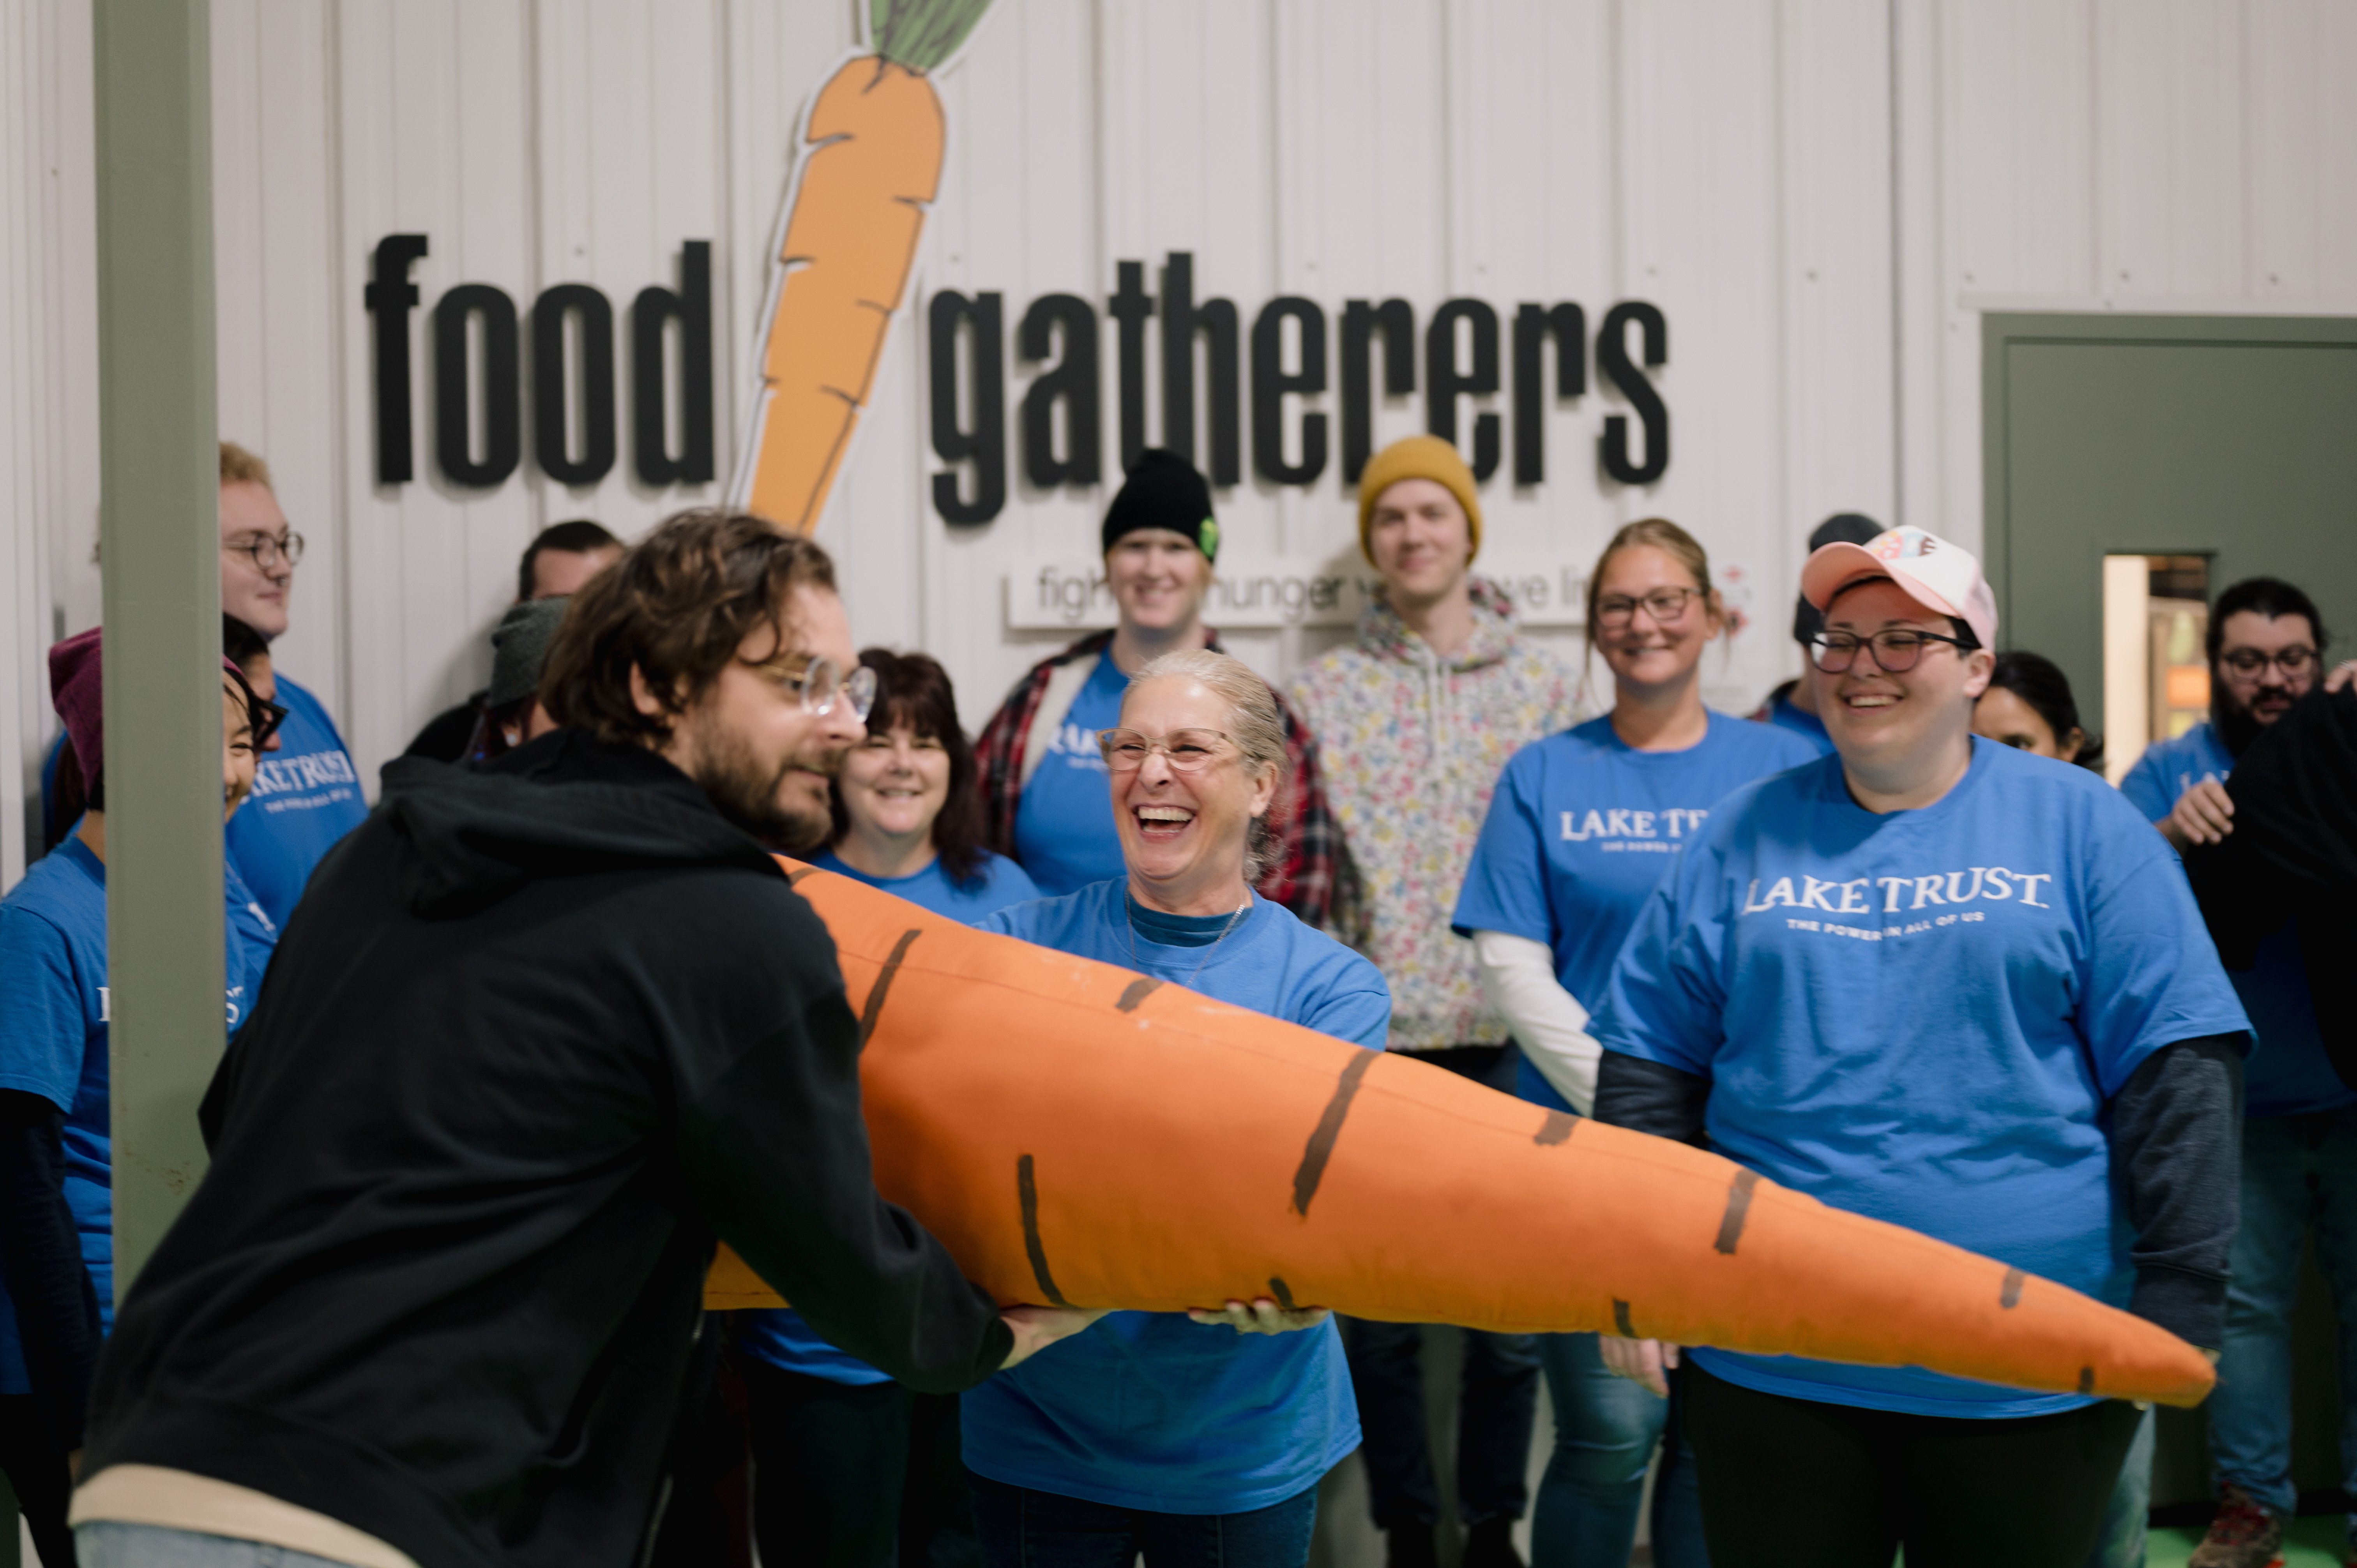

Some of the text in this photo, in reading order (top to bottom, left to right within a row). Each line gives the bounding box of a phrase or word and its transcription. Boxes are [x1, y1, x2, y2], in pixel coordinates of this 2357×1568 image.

[365, 235, 1670, 526] food gatherers
[1560, 808, 1657, 841] LAKE
[1741, 874, 1870, 916] LAKE
[1786, 918, 1820, 932] THE
[1823, 922, 1882, 941] POWER
[1904, 920, 1933, 934] ALL
[1935, 913, 1958, 927] OF
[1960, 911, 1986, 923] US
